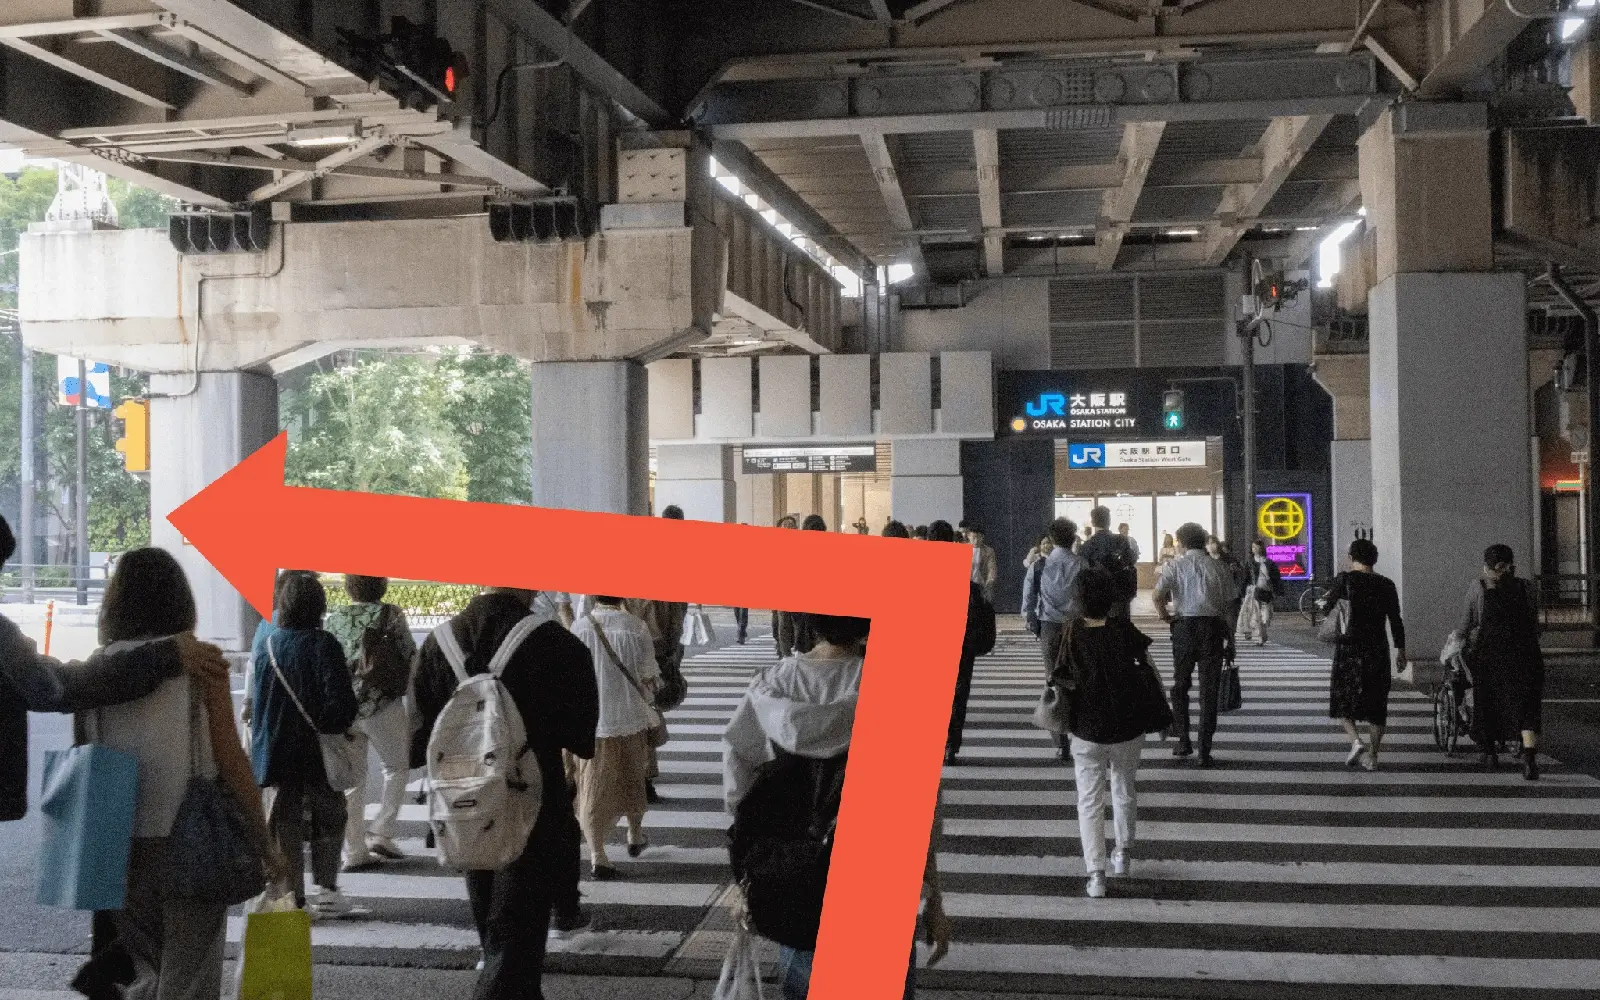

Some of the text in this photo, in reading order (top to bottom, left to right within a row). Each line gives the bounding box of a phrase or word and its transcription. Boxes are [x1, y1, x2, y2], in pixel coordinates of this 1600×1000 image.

[1026, 394, 1065, 416] JR
[1070, 393, 1125, 408] 大阪駅
[1033, 418, 1136, 429] OSAKA STATION CITY
[1073, 447, 1102, 464] JR
